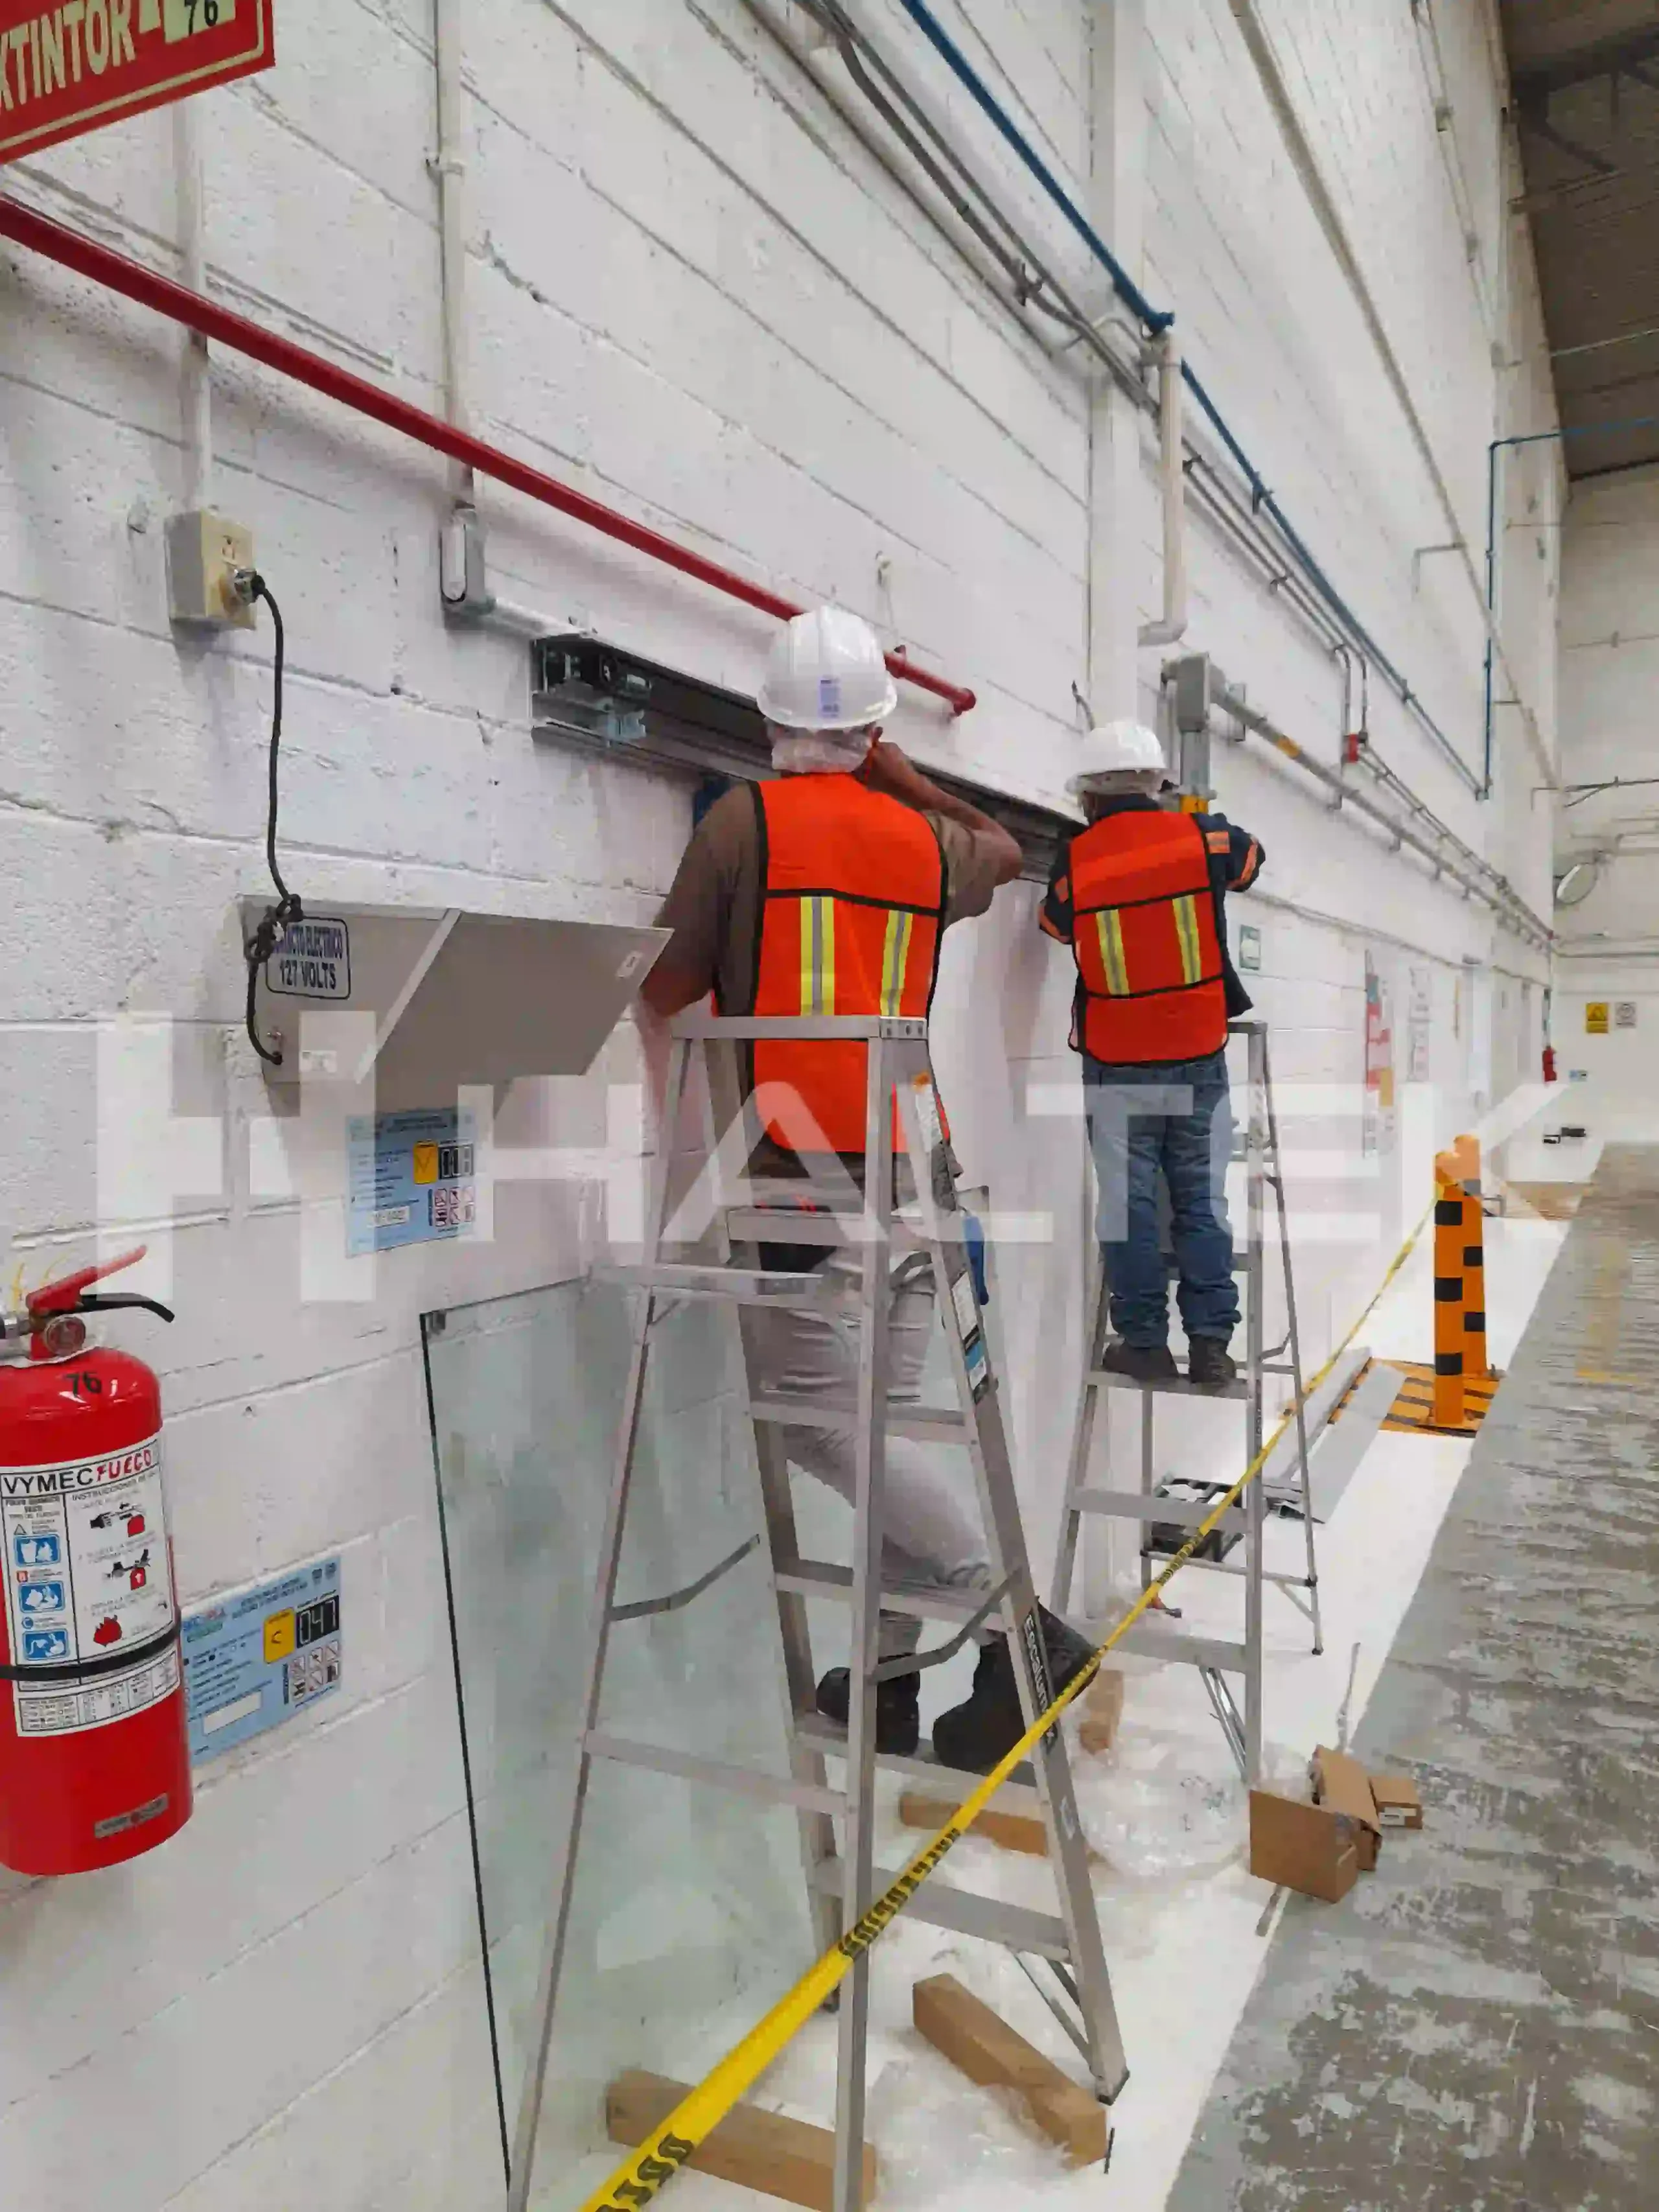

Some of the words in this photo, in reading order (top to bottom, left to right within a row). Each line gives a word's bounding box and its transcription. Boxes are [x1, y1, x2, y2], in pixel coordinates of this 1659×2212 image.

[279, 959, 297, 987] 127
[300, 960, 336, 990] VOLTS
[66, 1371, 102, 1398] 76
[299, 1599, 336, 1645] 047
